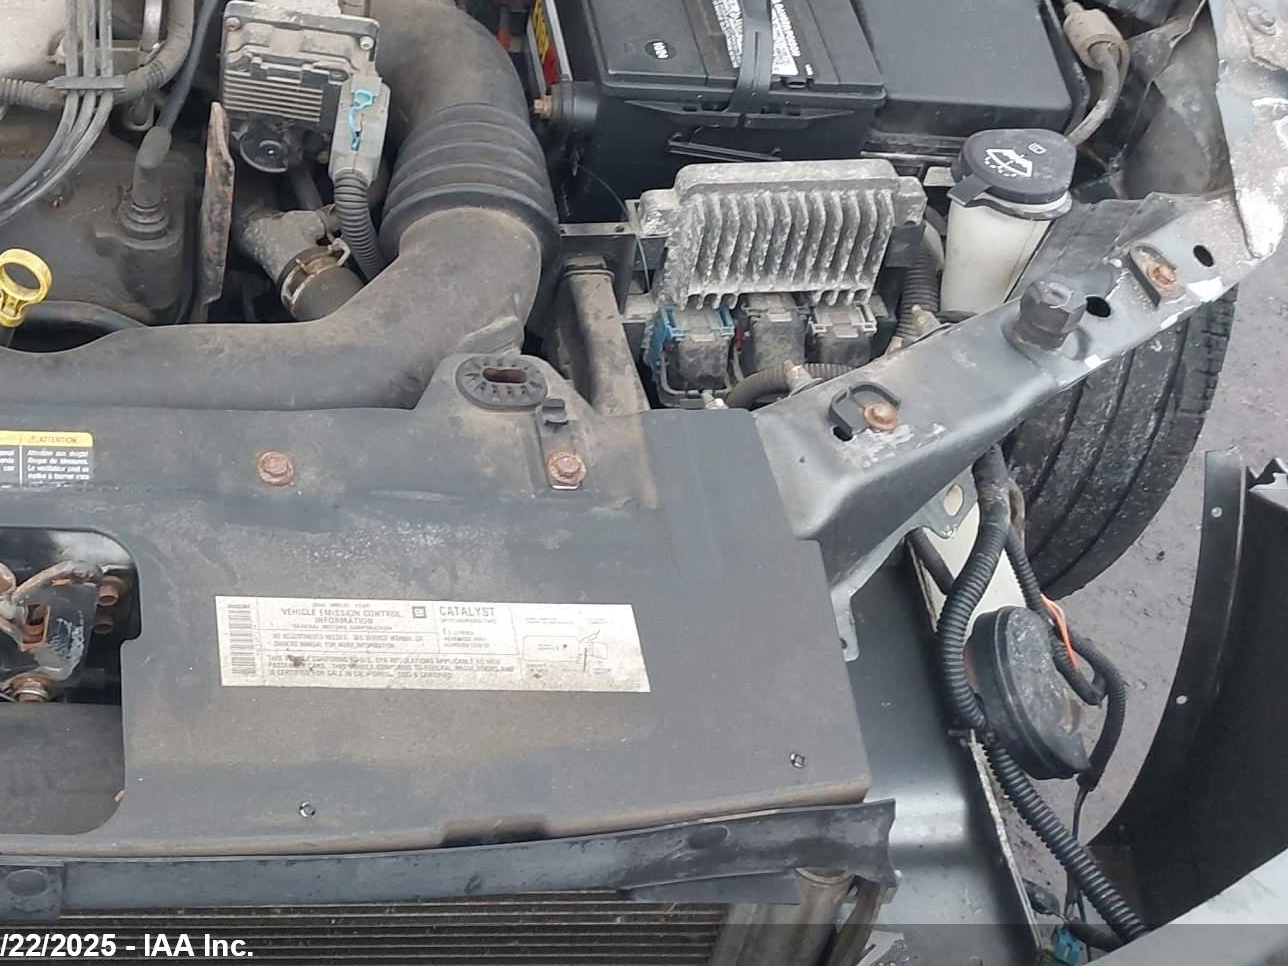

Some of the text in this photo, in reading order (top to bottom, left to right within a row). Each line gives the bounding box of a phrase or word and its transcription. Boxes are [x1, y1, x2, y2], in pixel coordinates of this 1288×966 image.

[281, 608, 316, 616] VEHICLE
[363, 610, 402, 618] CONTROL
[440, 606, 496, 617] CATALYST
